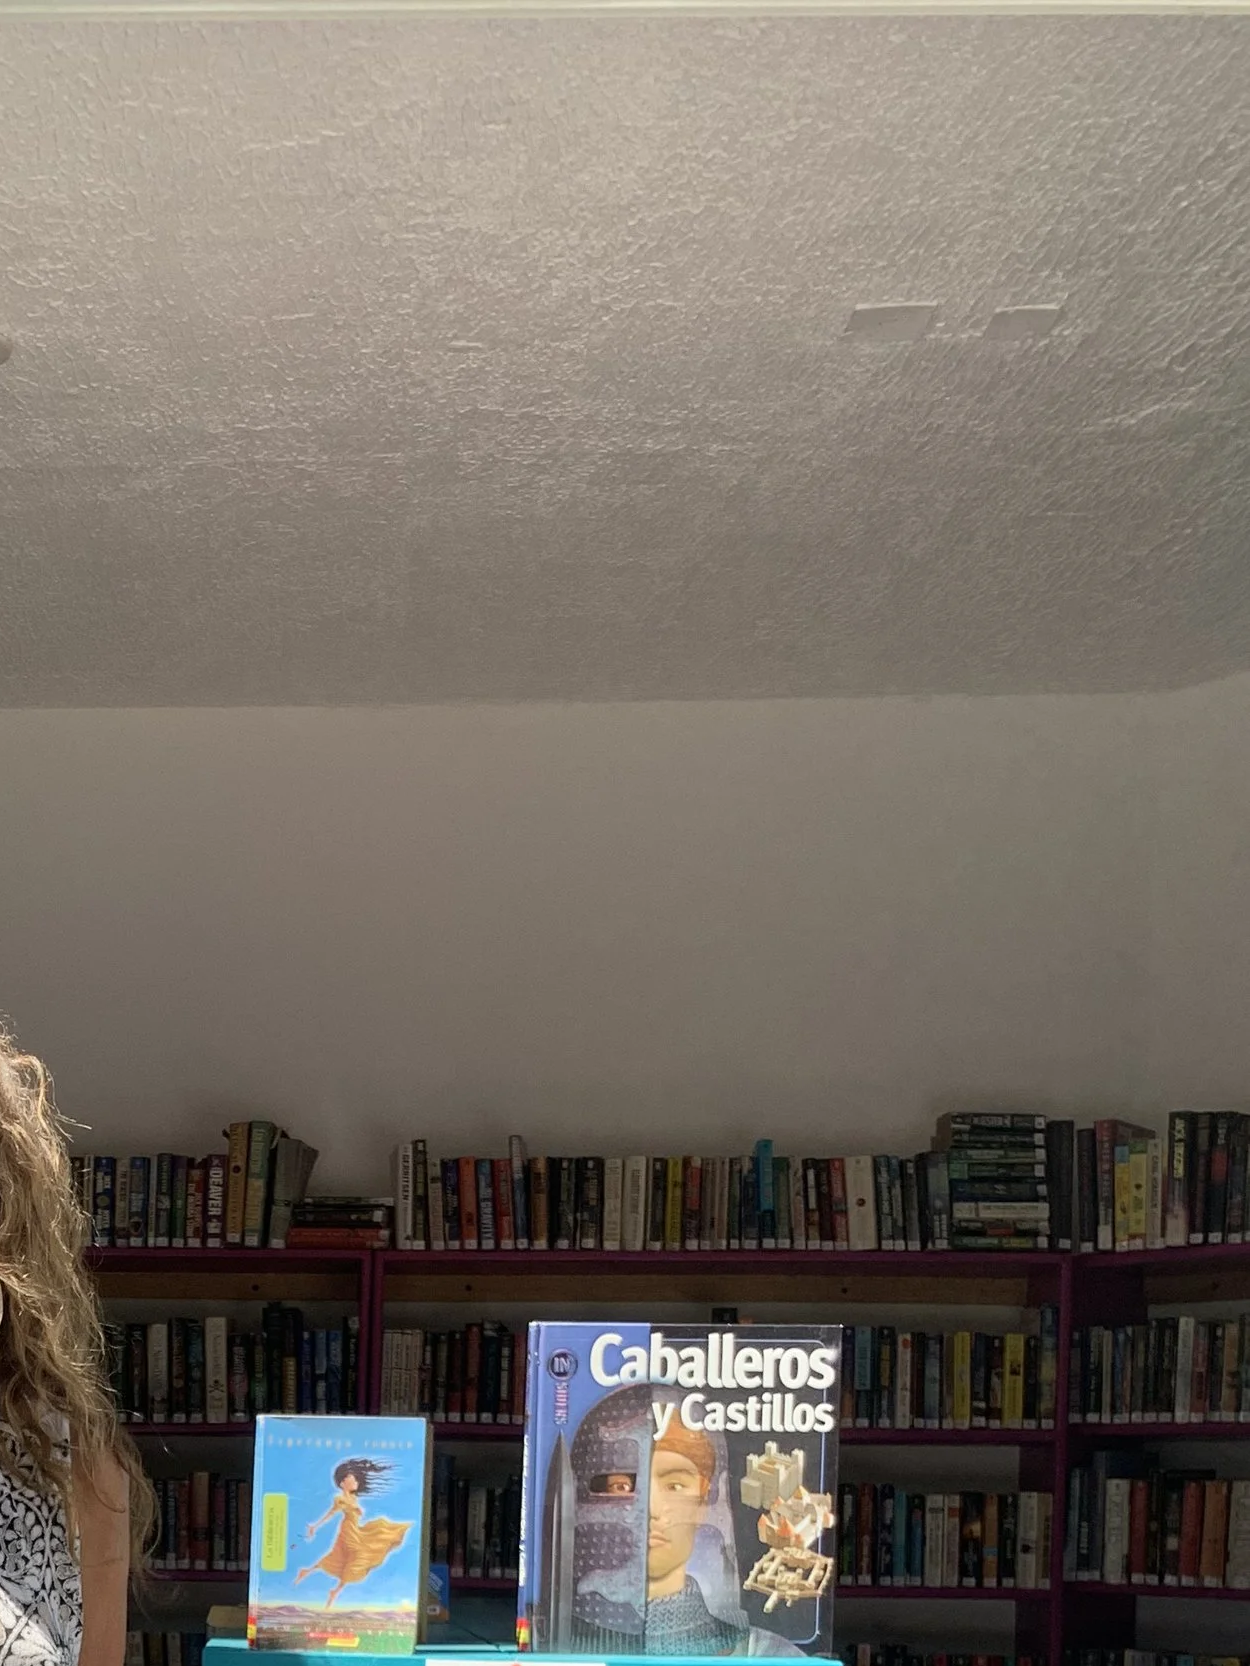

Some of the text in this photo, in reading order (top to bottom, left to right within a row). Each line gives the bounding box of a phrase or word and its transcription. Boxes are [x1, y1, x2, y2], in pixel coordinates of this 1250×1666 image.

[208, 1169, 224, 1216] DEAVER
[589, 1332, 837, 1390] Caballeros
[650, 1392, 835, 1441] y Castillos
